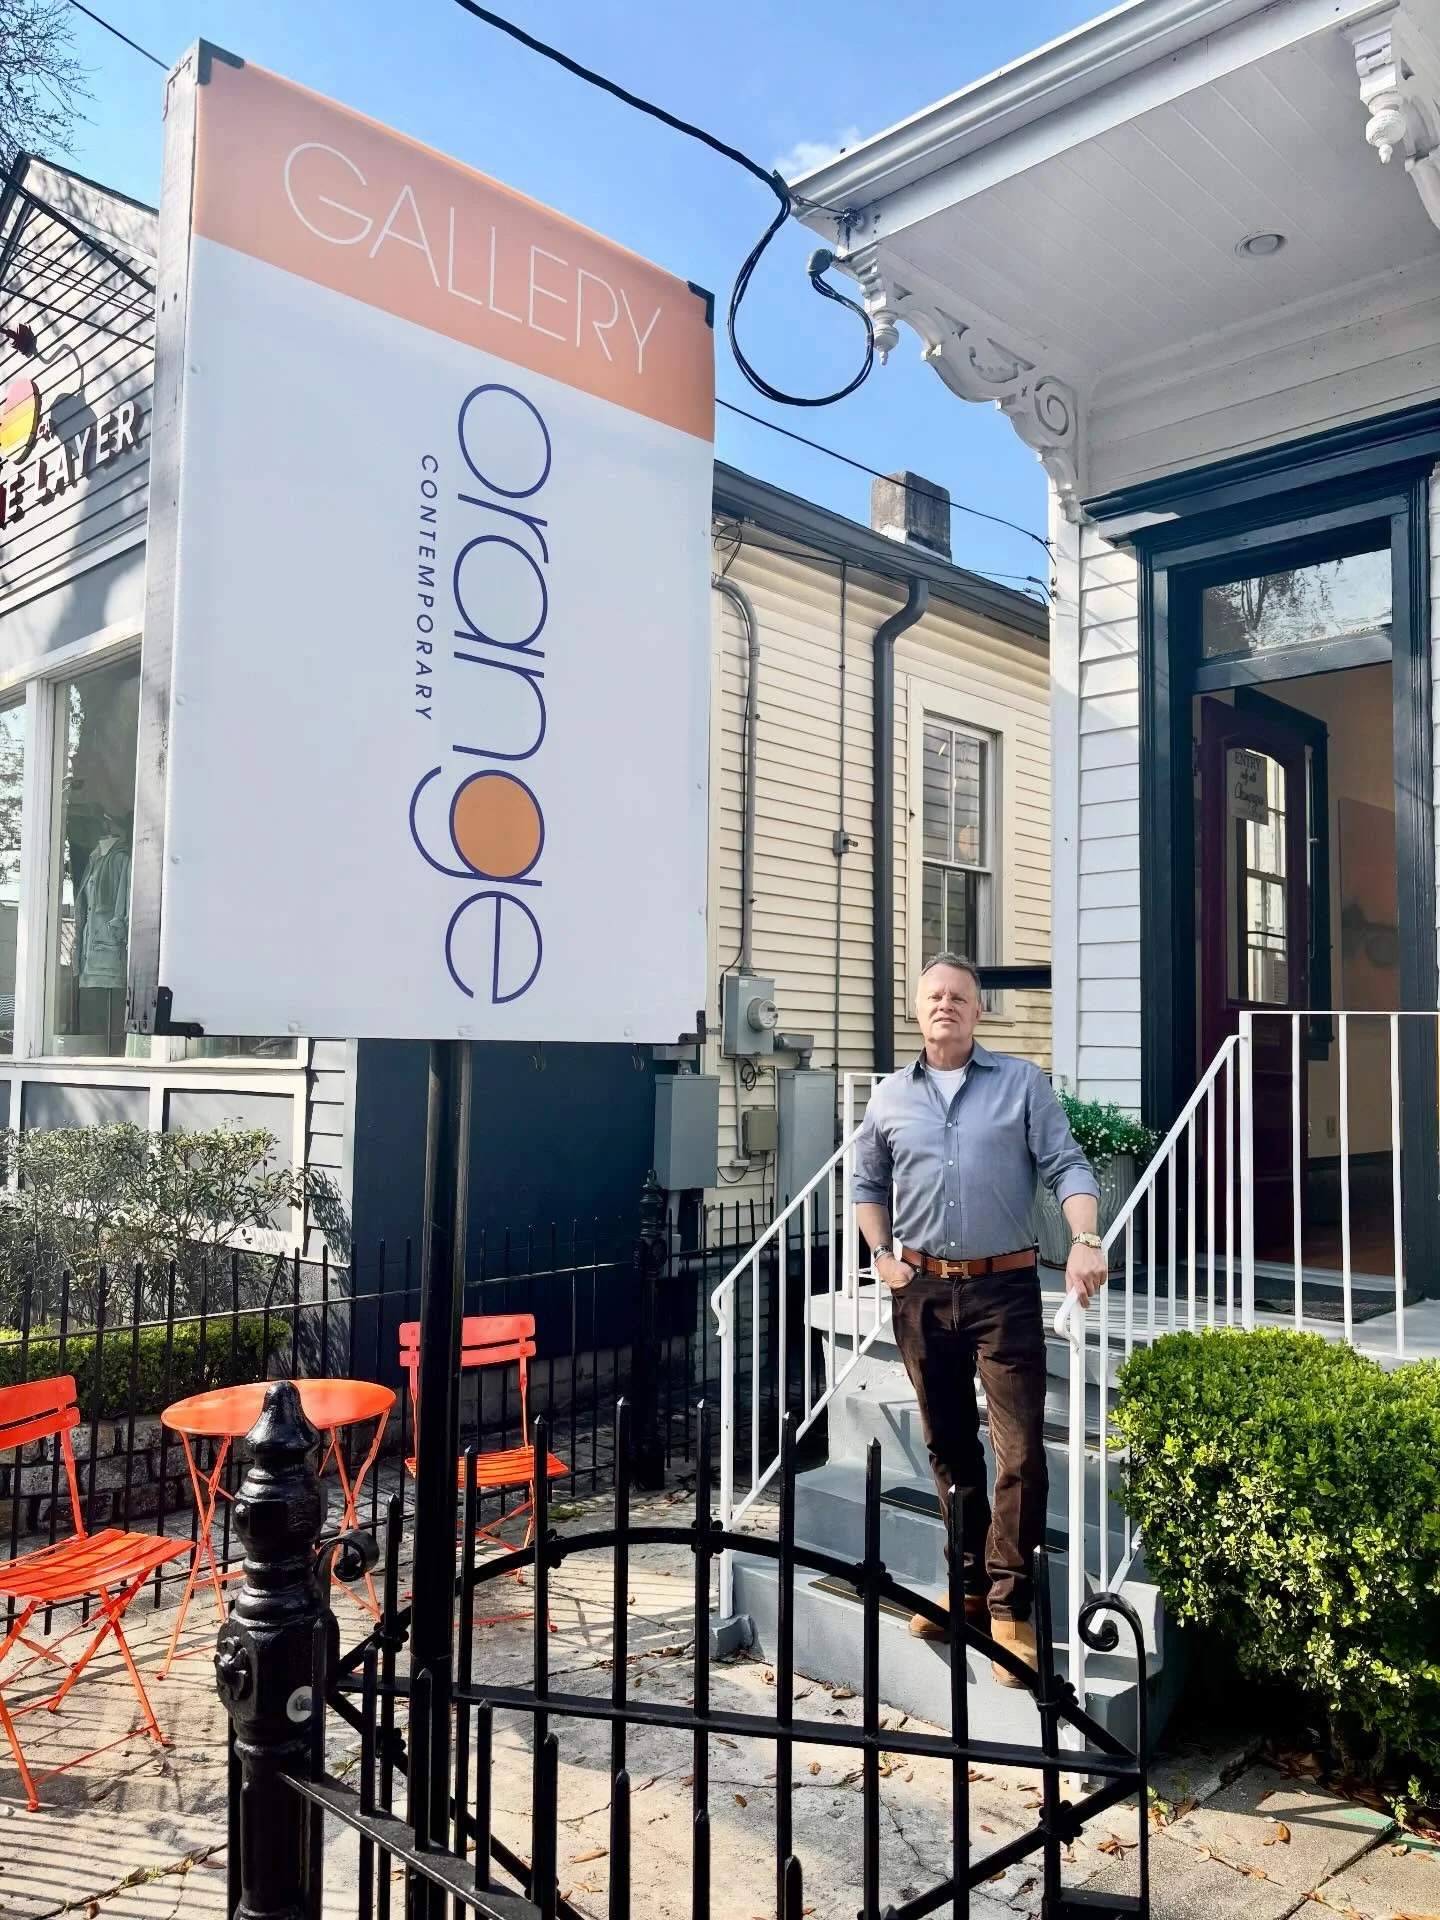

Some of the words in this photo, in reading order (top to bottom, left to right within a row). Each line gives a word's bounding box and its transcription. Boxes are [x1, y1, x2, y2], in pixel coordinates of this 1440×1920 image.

[283, 141, 662, 374] GALLERY
[35, 399, 136, 502] LAYER
[409, 383, 552, 1005] orange
[415, 454, 439, 721] CONTEMPORARY
